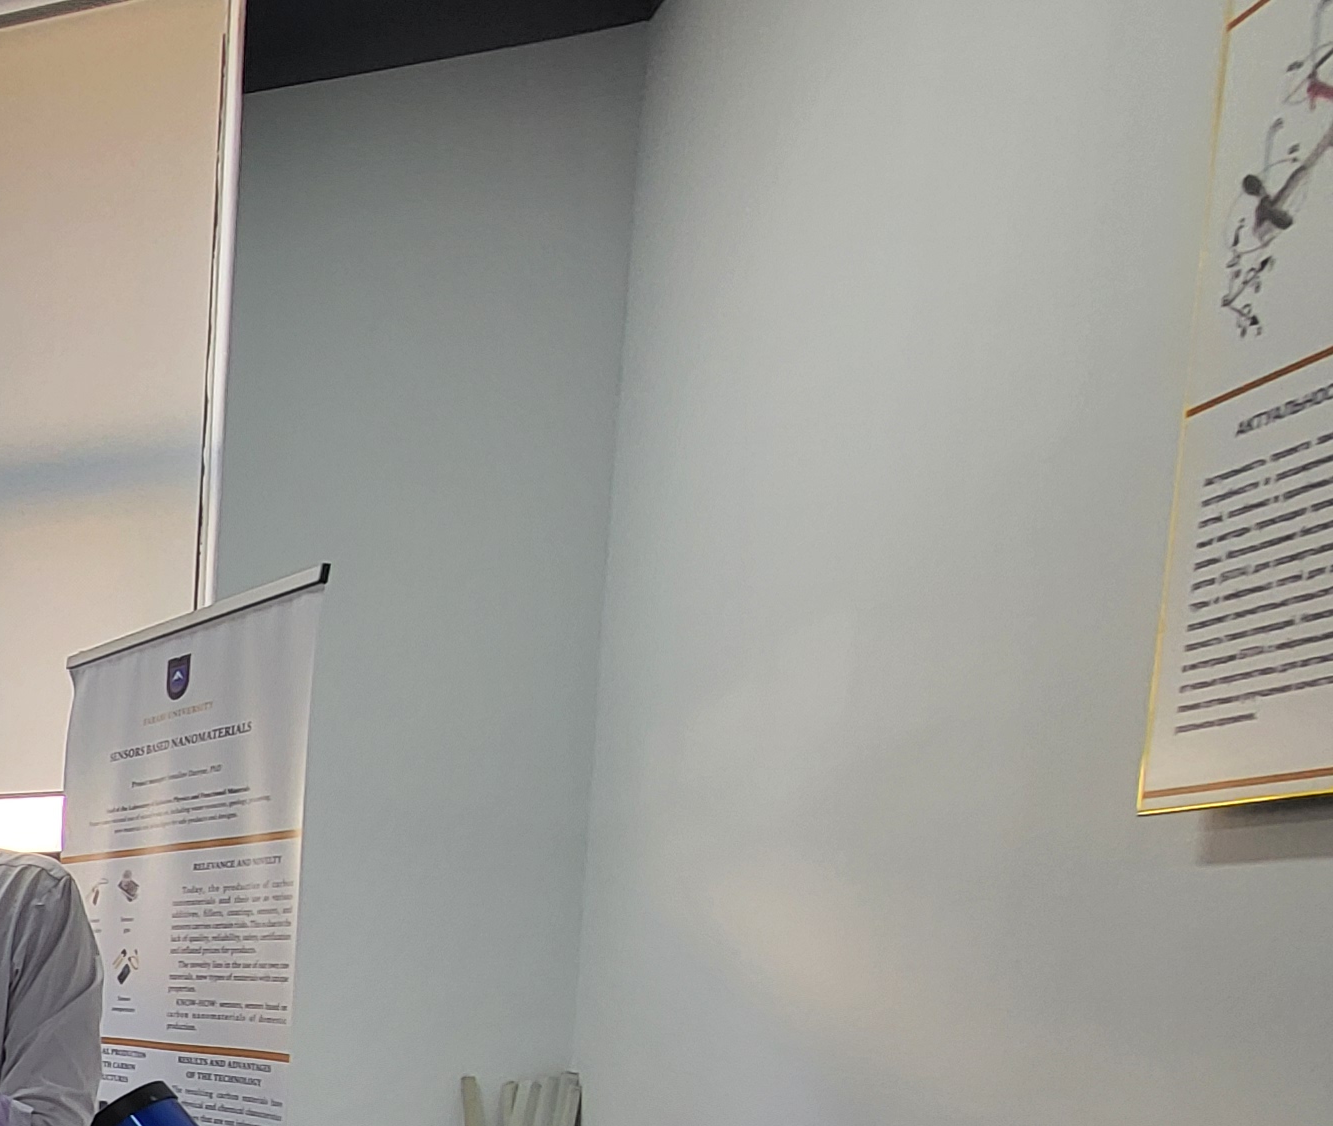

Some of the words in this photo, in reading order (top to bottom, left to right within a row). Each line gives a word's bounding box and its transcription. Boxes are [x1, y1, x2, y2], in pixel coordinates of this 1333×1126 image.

[167, 702, 213, 721] UNIVERSITY
[109, 746, 145, 762] SENSORS
[145, 740, 170, 756] BASED
[171, 721, 253, 749] NANOMATERIALS
[193, 860, 235, 872] RELEVANCE
[182, 886, 203, 895] Today,
[208, 884, 220, 894] the
[178, 1056, 208, 1066] RESULTS
[209, 1058, 226, 1068] AND
[227, 1060, 271, 1073] ADVANTAGES
[186, 1071, 196, 1079] OF
[197, 1072, 213, 1082] THE
[214, 1074, 262, 1087] TECHNOLOGY
